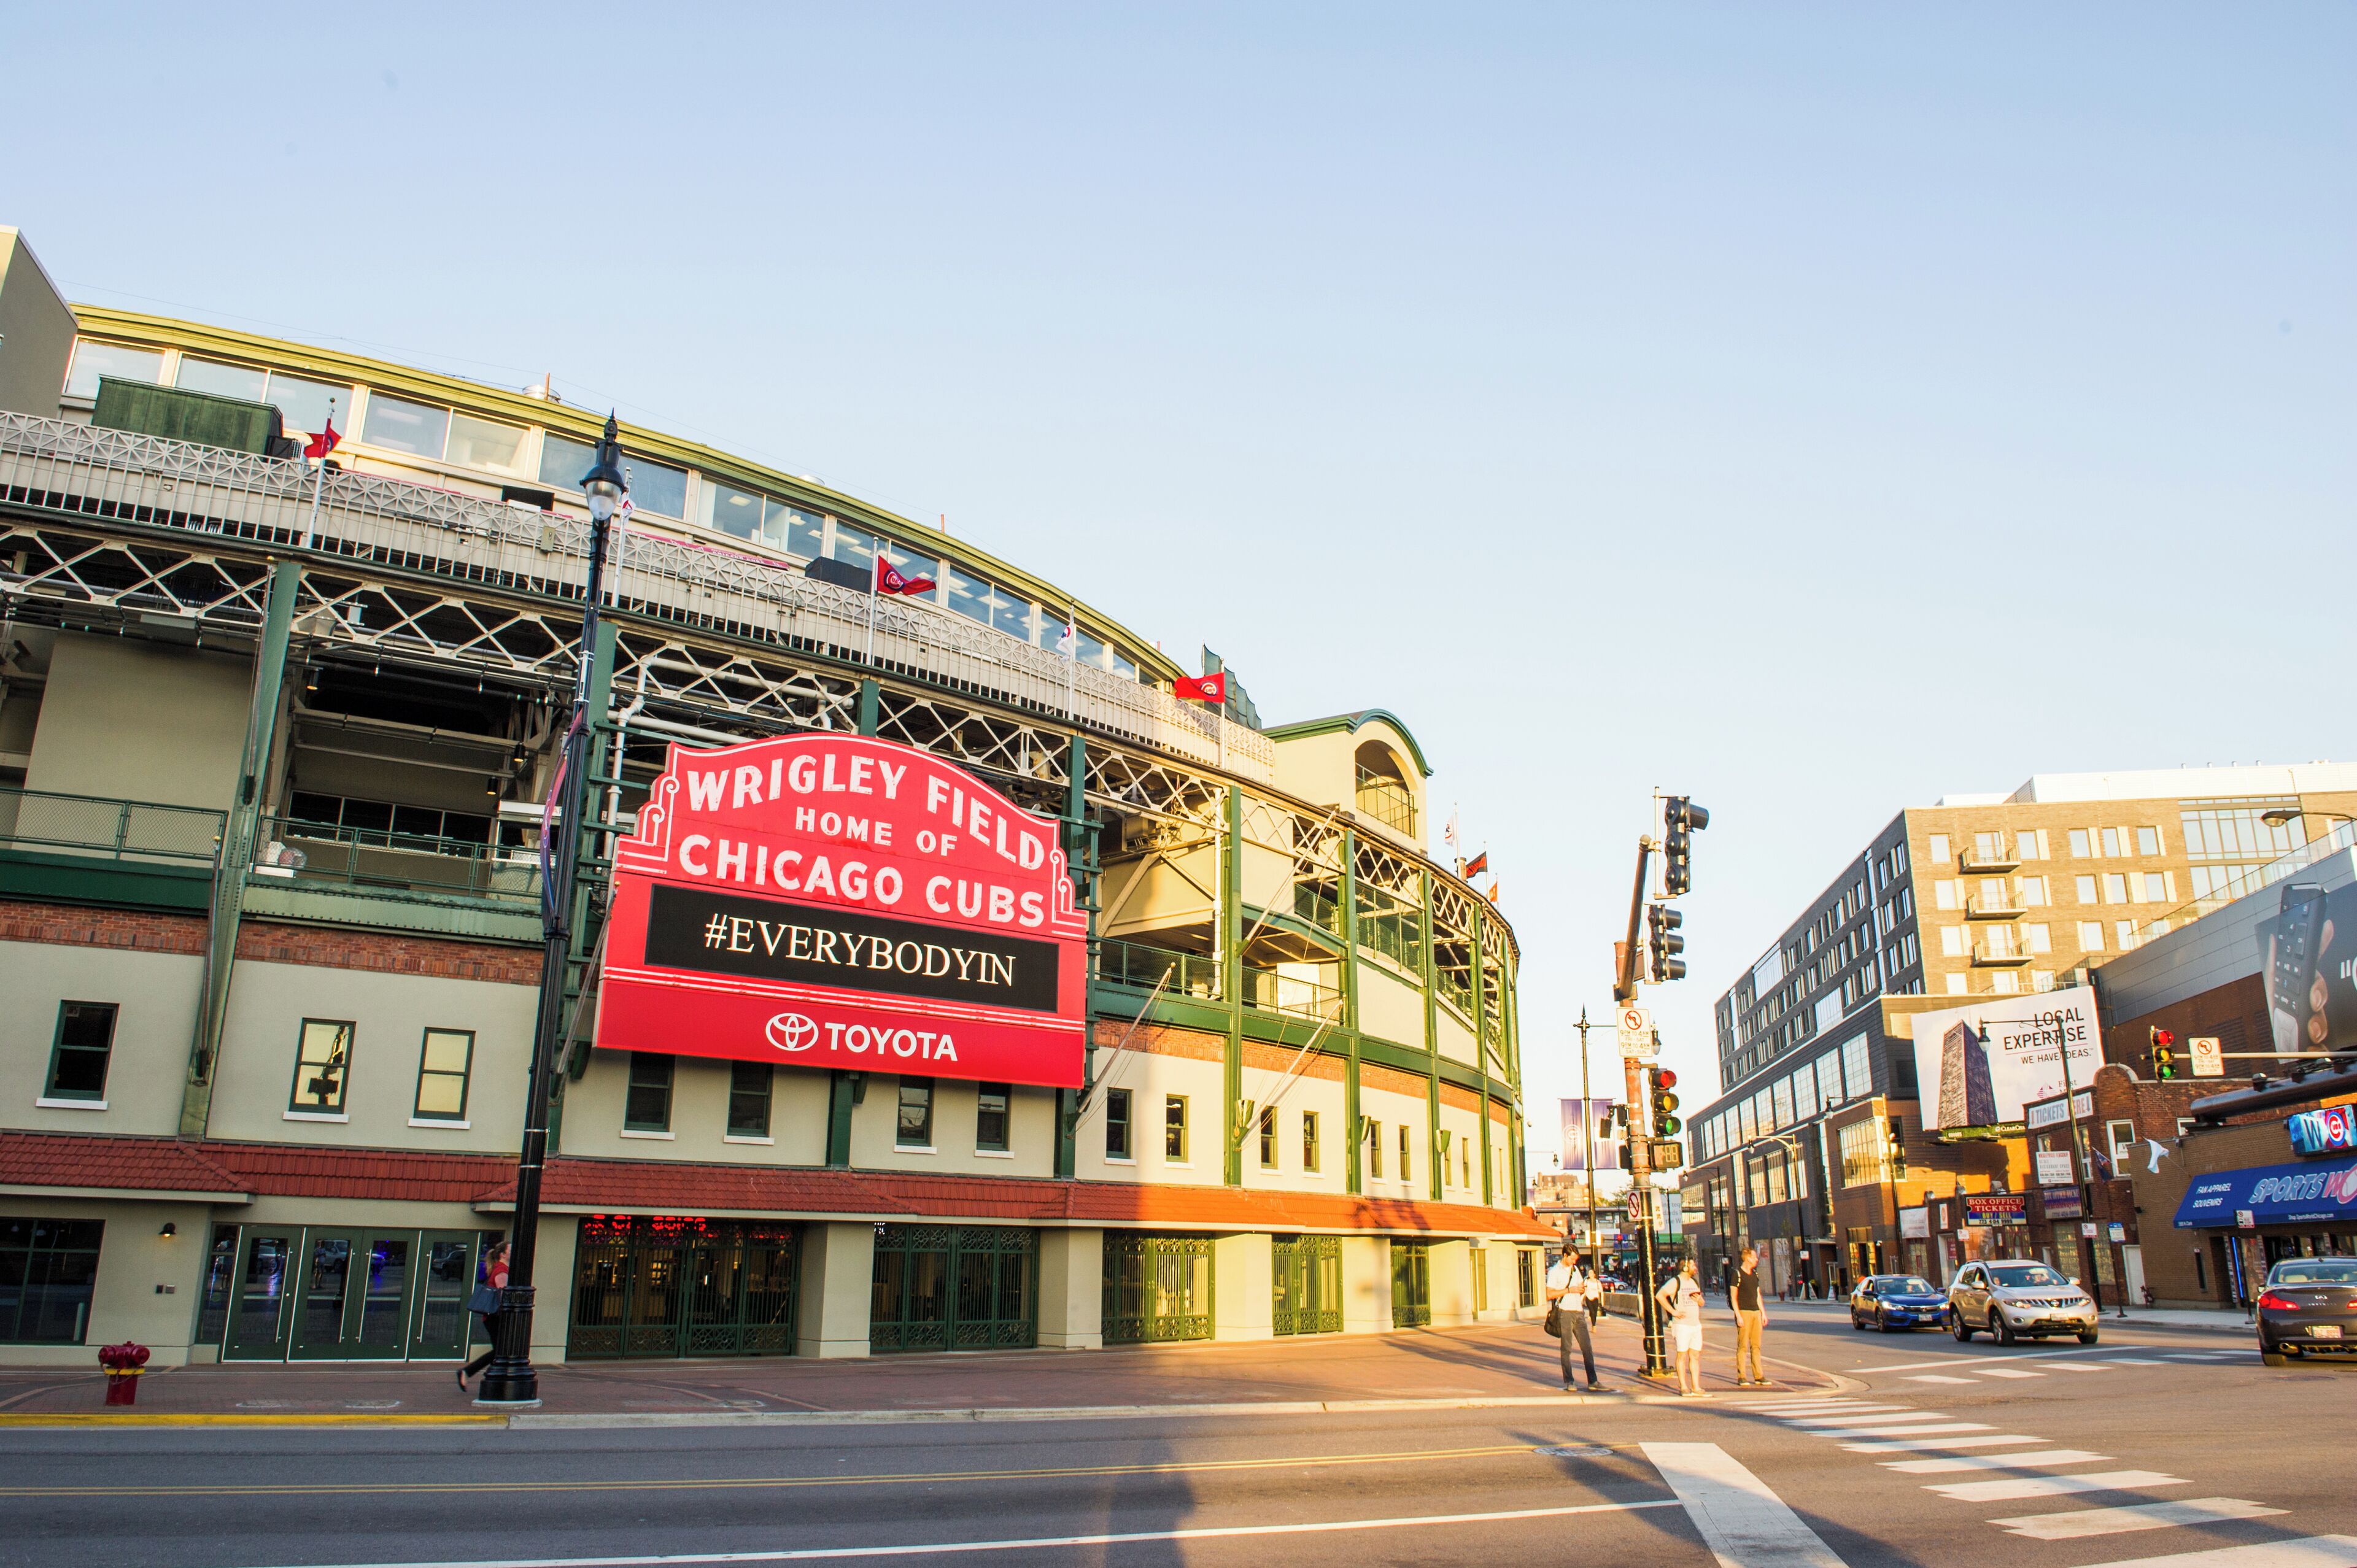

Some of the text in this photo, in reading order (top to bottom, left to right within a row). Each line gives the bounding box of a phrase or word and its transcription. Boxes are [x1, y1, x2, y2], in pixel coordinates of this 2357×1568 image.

[687, 753, 1046, 871] WRIGLEY FIELD
[795, 806, 958, 857] HOME OF
[679, 833, 1045, 927] CHICAGO CUBS
[705, 913, 1016, 987] #EVERYBODYIN
[2034, 1007, 2084, 1027] LOCAL
[825, 1021, 958, 1062] TOYOTA
[2021, 1056, 2034, 1064] WE
[2037, 1052, 2059, 1062] HAVE
[2035, 1103, 2064, 1124] TICKETS
[2196, 1185, 2208, 1194] FAN
